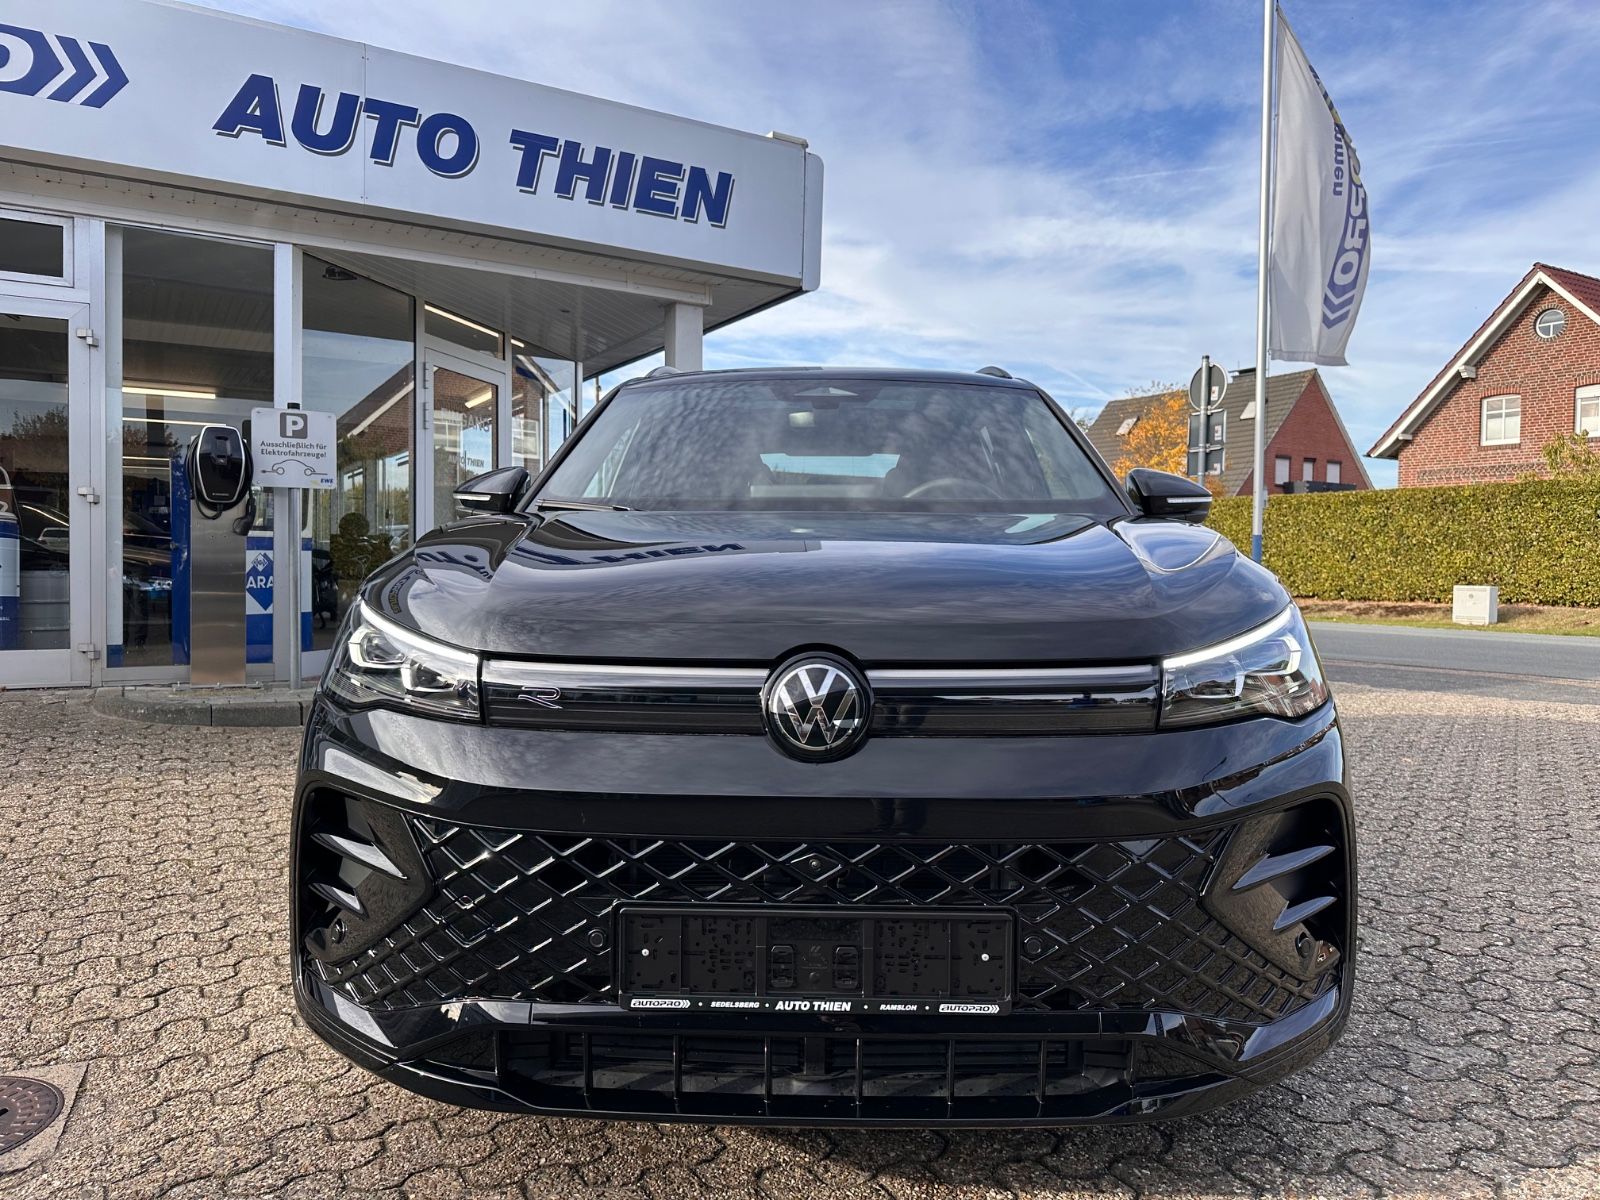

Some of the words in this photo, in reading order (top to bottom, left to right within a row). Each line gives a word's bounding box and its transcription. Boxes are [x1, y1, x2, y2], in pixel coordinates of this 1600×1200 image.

[212, 74, 480, 178] AUTO
[509, 129, 735, 229] THIEN
[285, 415, 304, 436] P
[260, 441, 314, 449] Ausschließlich
[260, 448, 327, 459] Elektrofahrzeuge!
[246, 575, 273, 589] ARA
[710, 1001, 760, 1009] SEDELSBERG
[774, 1001, 811, 1011] AUTO
[812, 1001, 852, 1012] THIEN
